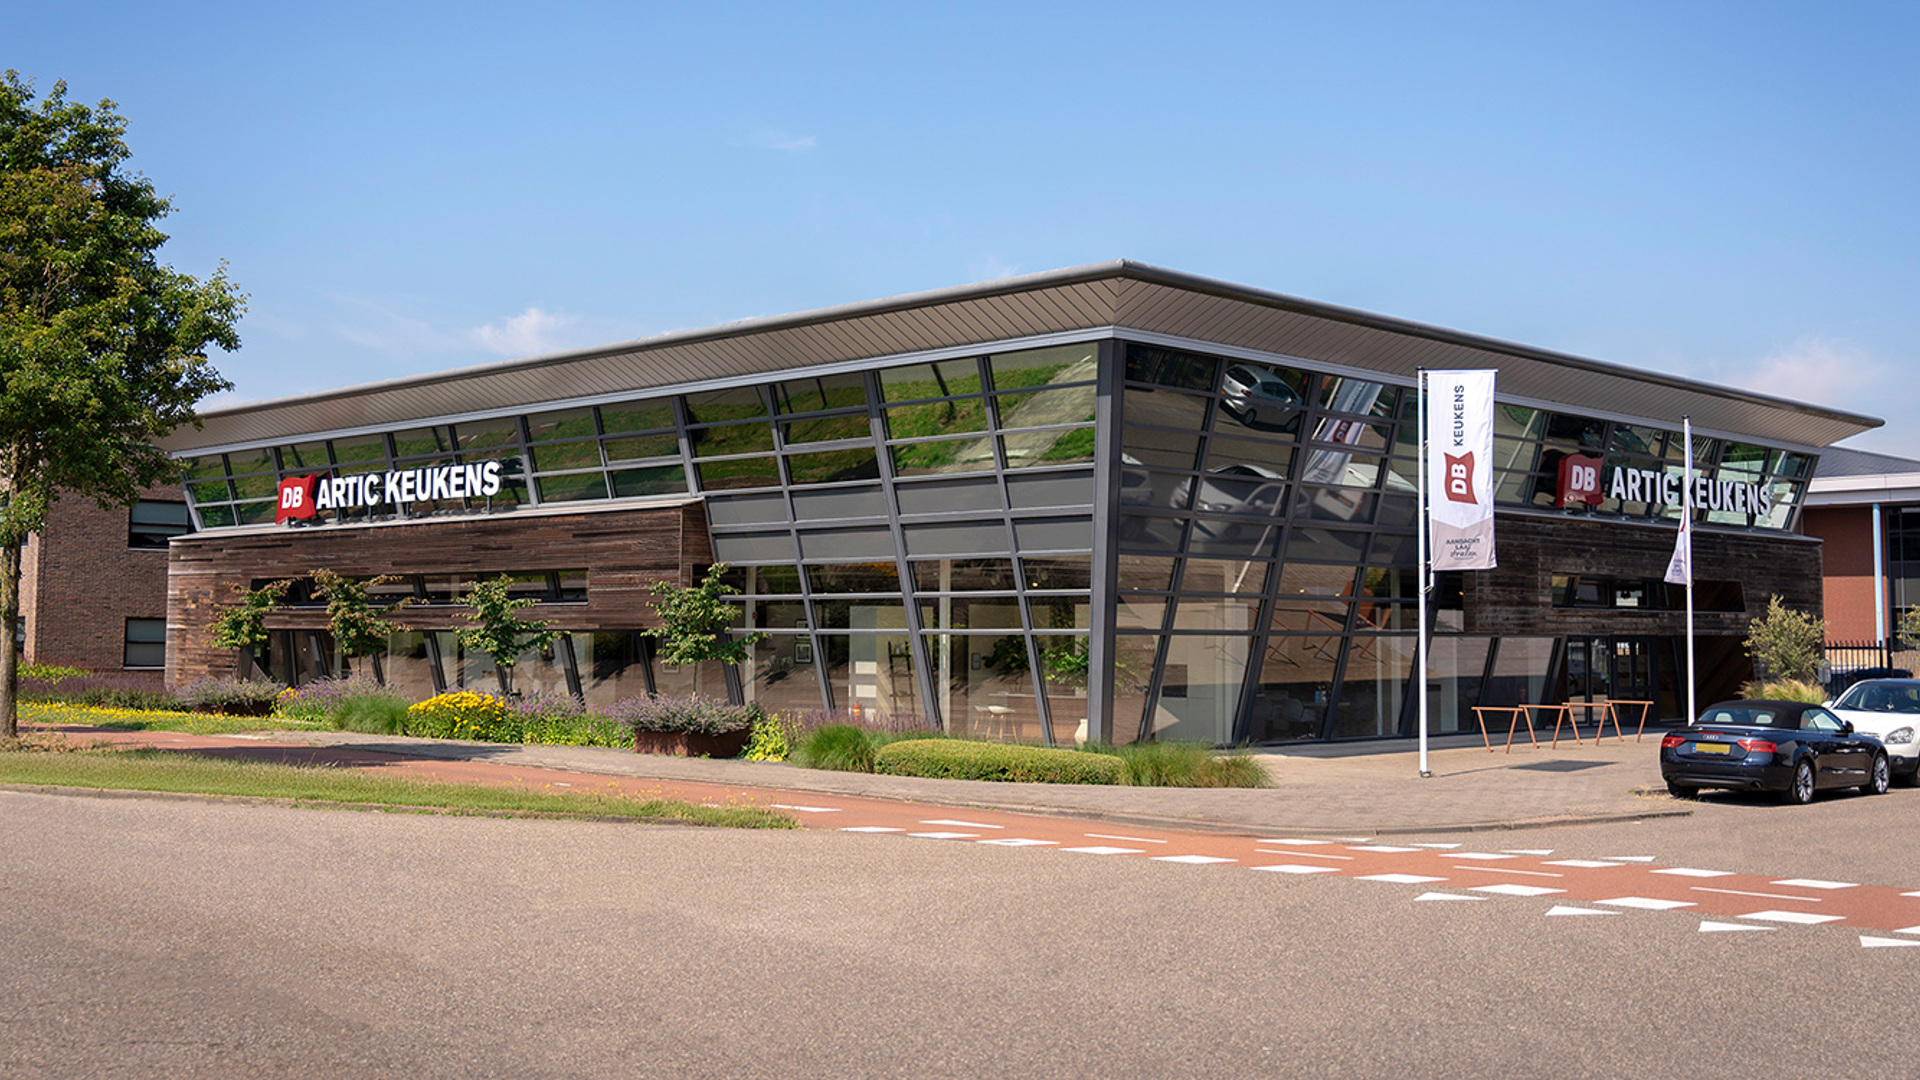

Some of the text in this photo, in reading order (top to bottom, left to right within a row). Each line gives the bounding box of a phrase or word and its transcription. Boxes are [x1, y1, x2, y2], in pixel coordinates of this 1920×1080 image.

[1451, 385, 1468, 495] DB KEUKENS
[281, 461, 500, 509] DB ARTIC KEUKENS
[1571, 465, 1596, 492] DB
[1610, 466, 1678, 504] ARTIC
